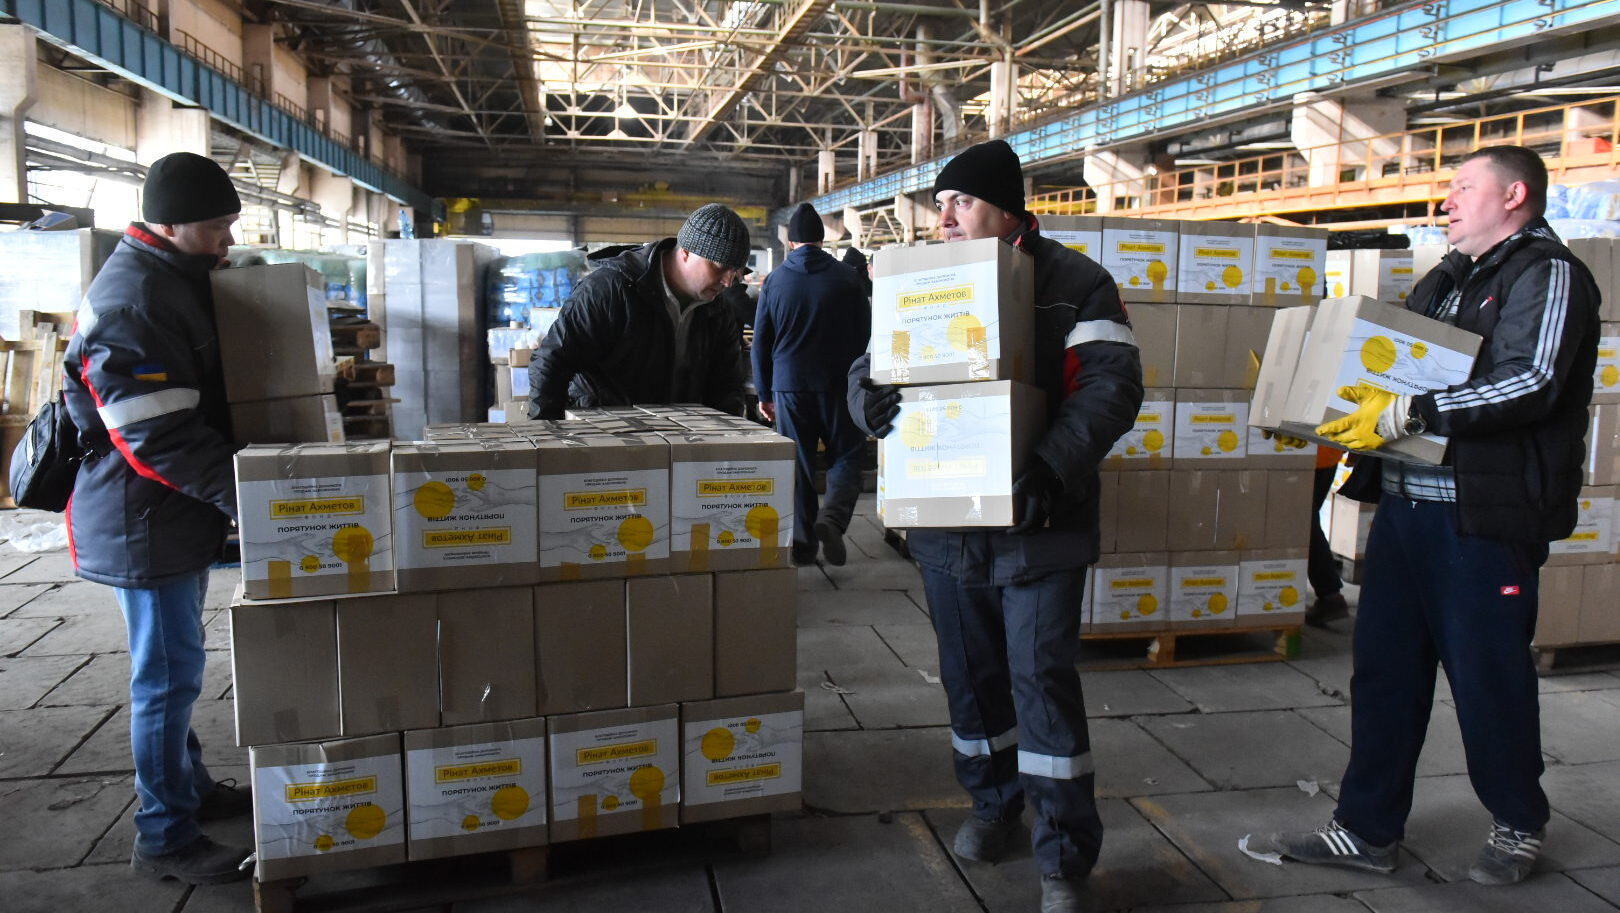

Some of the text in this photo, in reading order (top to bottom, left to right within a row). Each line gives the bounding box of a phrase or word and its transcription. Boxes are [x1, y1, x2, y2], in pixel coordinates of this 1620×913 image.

[903, 290, 967, 306] Рінат Ахметов
[902, 310, 970, 324] ПОРЯТУНОК ЖИТТІВ
[1366, 367, 1430, 393] ОРЯТУНОК ЖИТТІВ
[703, 483, 767, 492] Рінат Ахметов
[572, 494, 639, 504] Рінат Ахметов
[278, 502, 356, 513] Рінат Ахметов
[458, 513, 505, 521] ПОРЯТУНОК
[570, 516, 614, 524] ПОРЯТУНОК
[278, 522, 360, 534] ПОРЯТУНОК ЖИТТІВ
[432, 532, 503, 542] Рінат Ахметов
[584, 746, 649, 760] Рінат Ахметов
[738, 752, 776, 760] ПОРЯТУНОК
[443, 764, 513, 778] Рінат Ахметов
[582, 762, 654, 778] ПОРЯТУНОК ЖИТТІВ
[713, 768, 774, 780] Рінат Ахметов
[294, 782, 369, 796] Рінат Ахметов
[442, 782, 517, 796] ПОРЯТУНОК ЖИТТІВ
[292, 801, 372, 816] ПОРЯТУНОК ЖИТТІВ
